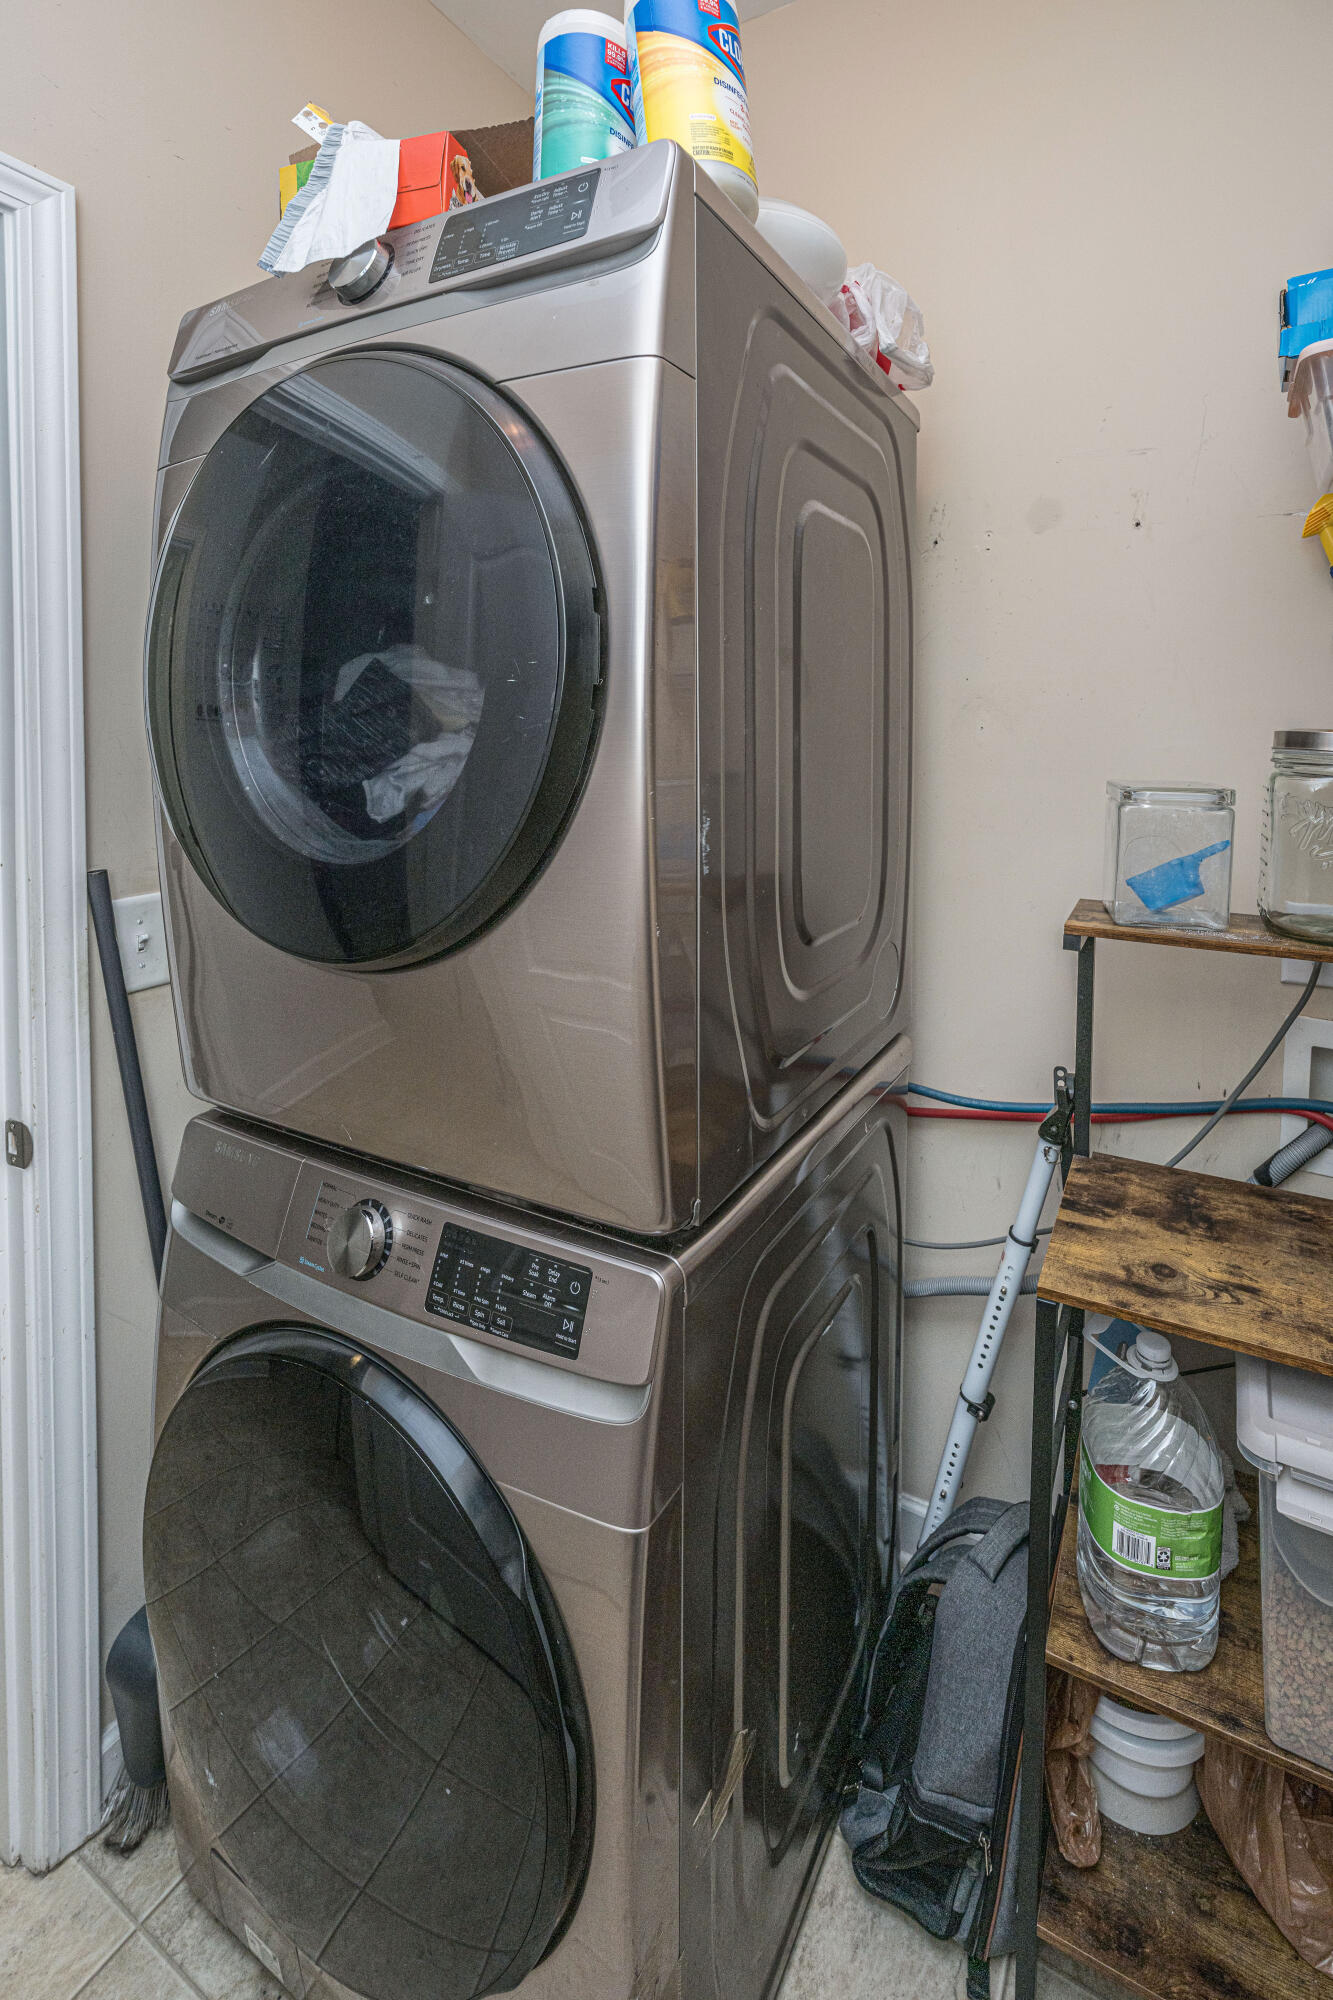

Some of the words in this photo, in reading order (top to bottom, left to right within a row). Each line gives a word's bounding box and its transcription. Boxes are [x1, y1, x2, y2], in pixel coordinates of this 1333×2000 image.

[607, 42, 626, 58] KILLS
[531, 1262, 539, 1271] Pre
[528, 1268, 539, 1278] Soak
[548, 1268, 561, 1279] Delay
[548, 1276, 558, 1284] End
[522, 1289, 537, 1300] Steam
[452, 1301, 465, 1311] Rinse
[474, 1309, 486, 1319] Spin
[496, 1317, 506, 1327] Soil
